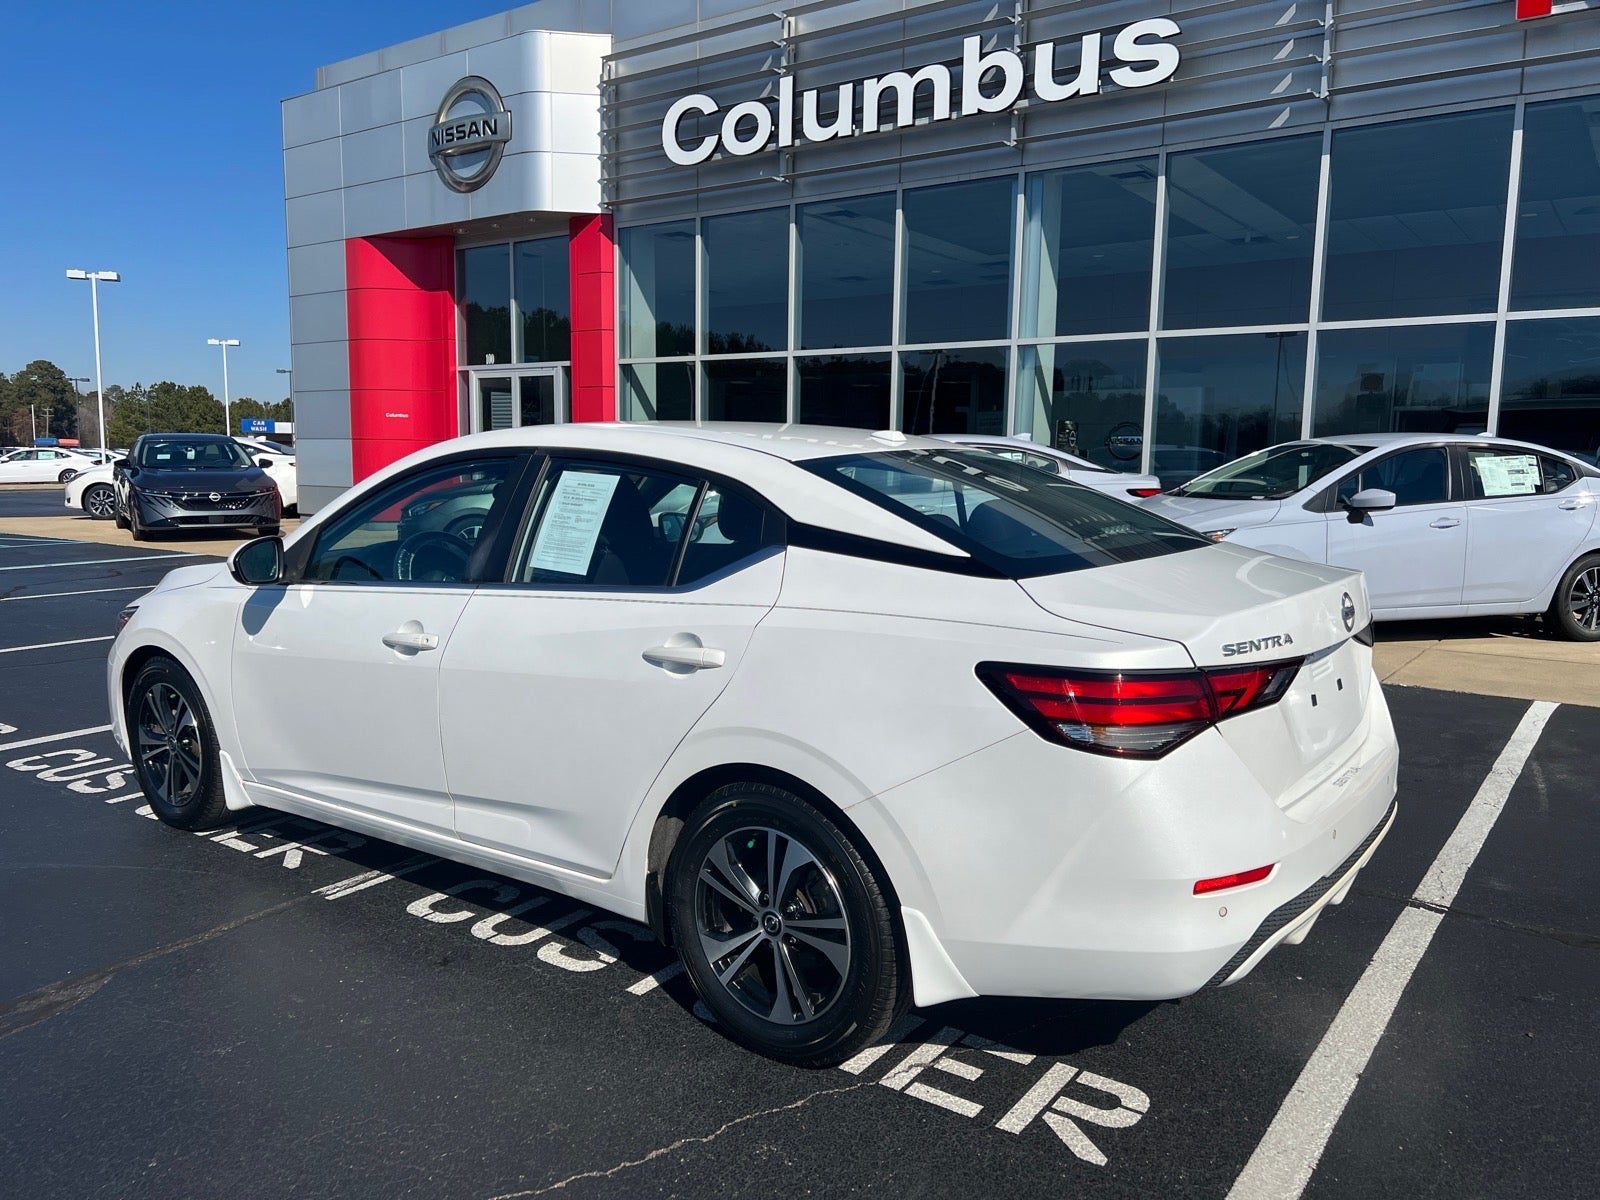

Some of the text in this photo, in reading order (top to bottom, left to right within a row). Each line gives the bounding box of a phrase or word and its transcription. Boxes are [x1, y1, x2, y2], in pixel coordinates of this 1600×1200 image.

[661, 17, 1182, 166] Columbus
[431, 118, 498, 147] NISSAN
[1222, 633, 1294, 657] SENTRA
